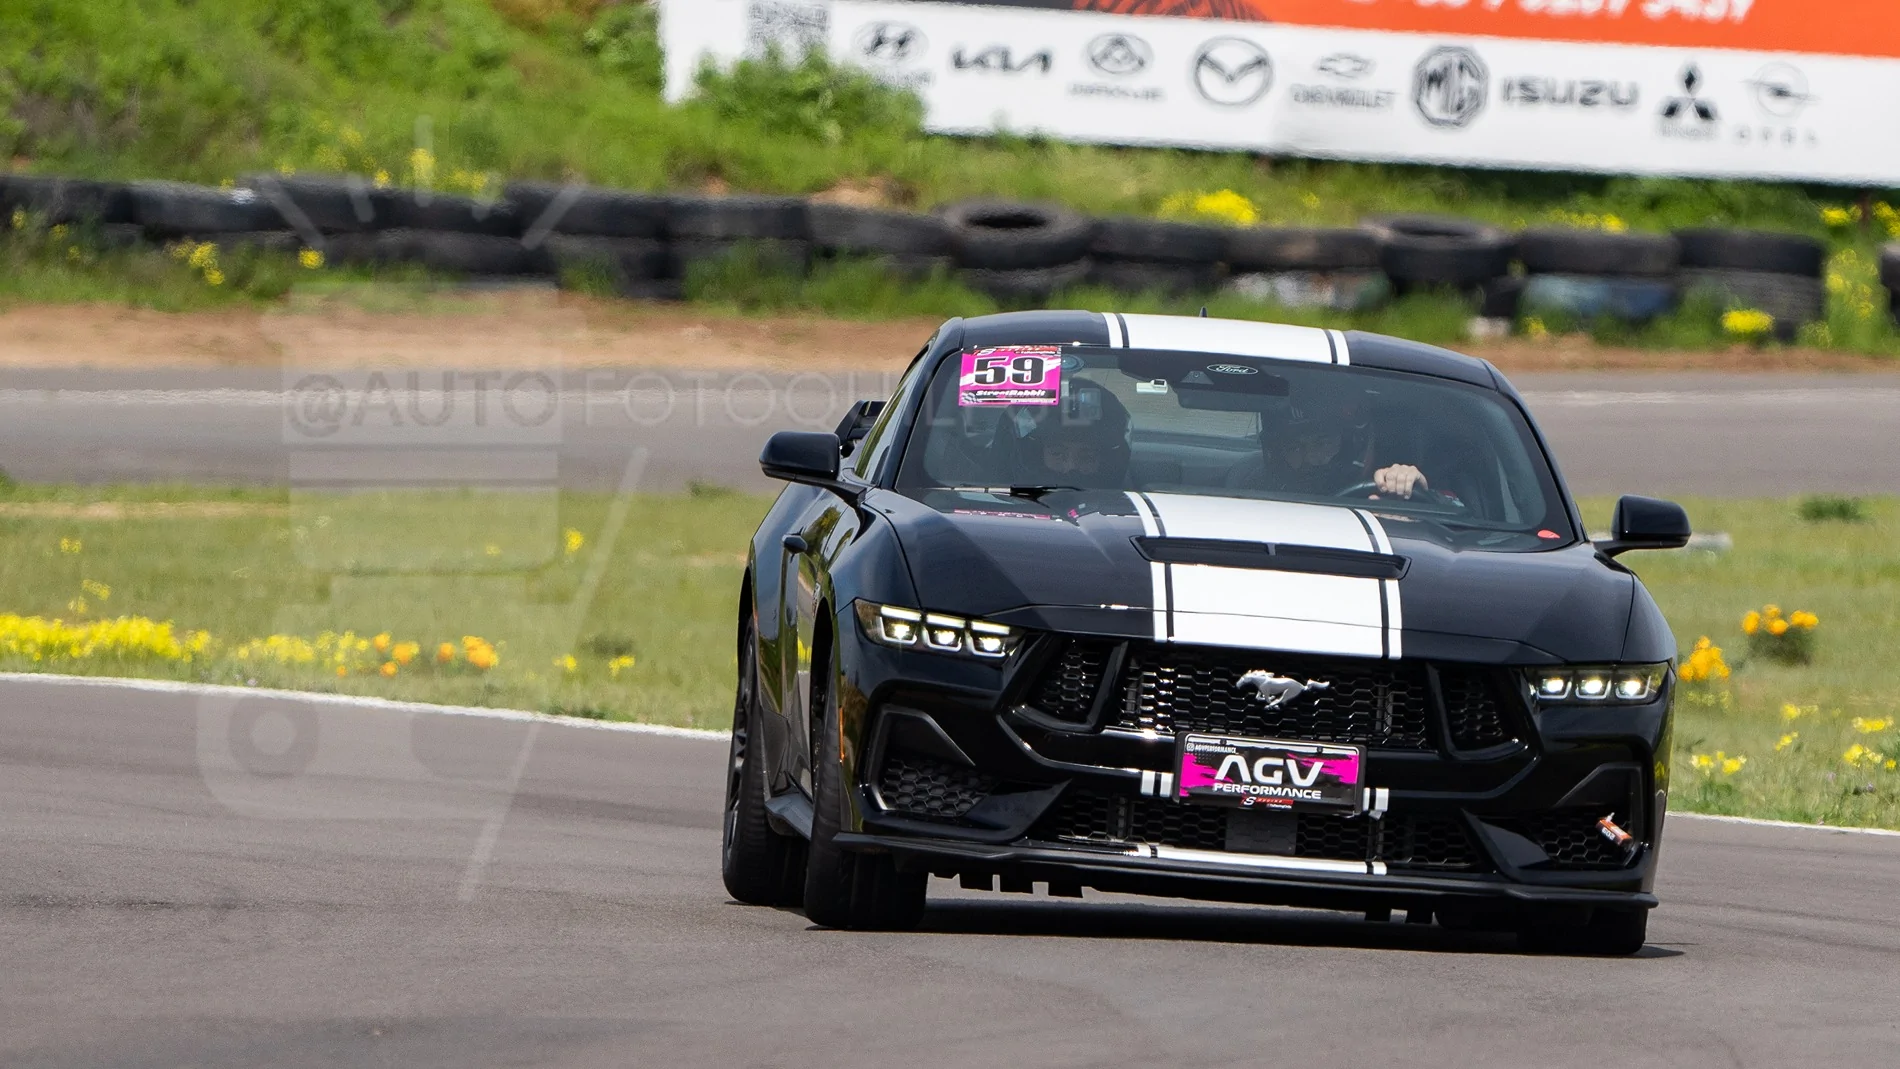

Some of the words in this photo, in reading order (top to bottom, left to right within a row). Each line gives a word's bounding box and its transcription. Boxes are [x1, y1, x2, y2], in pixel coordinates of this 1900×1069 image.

[1500, 76, 1640, 106] ISUZU
[974, 356, 1046, 386] 59
[1214, 754, 1324, 787] AGV
[1212, 783, 1322, 799] PERFORMANCE
